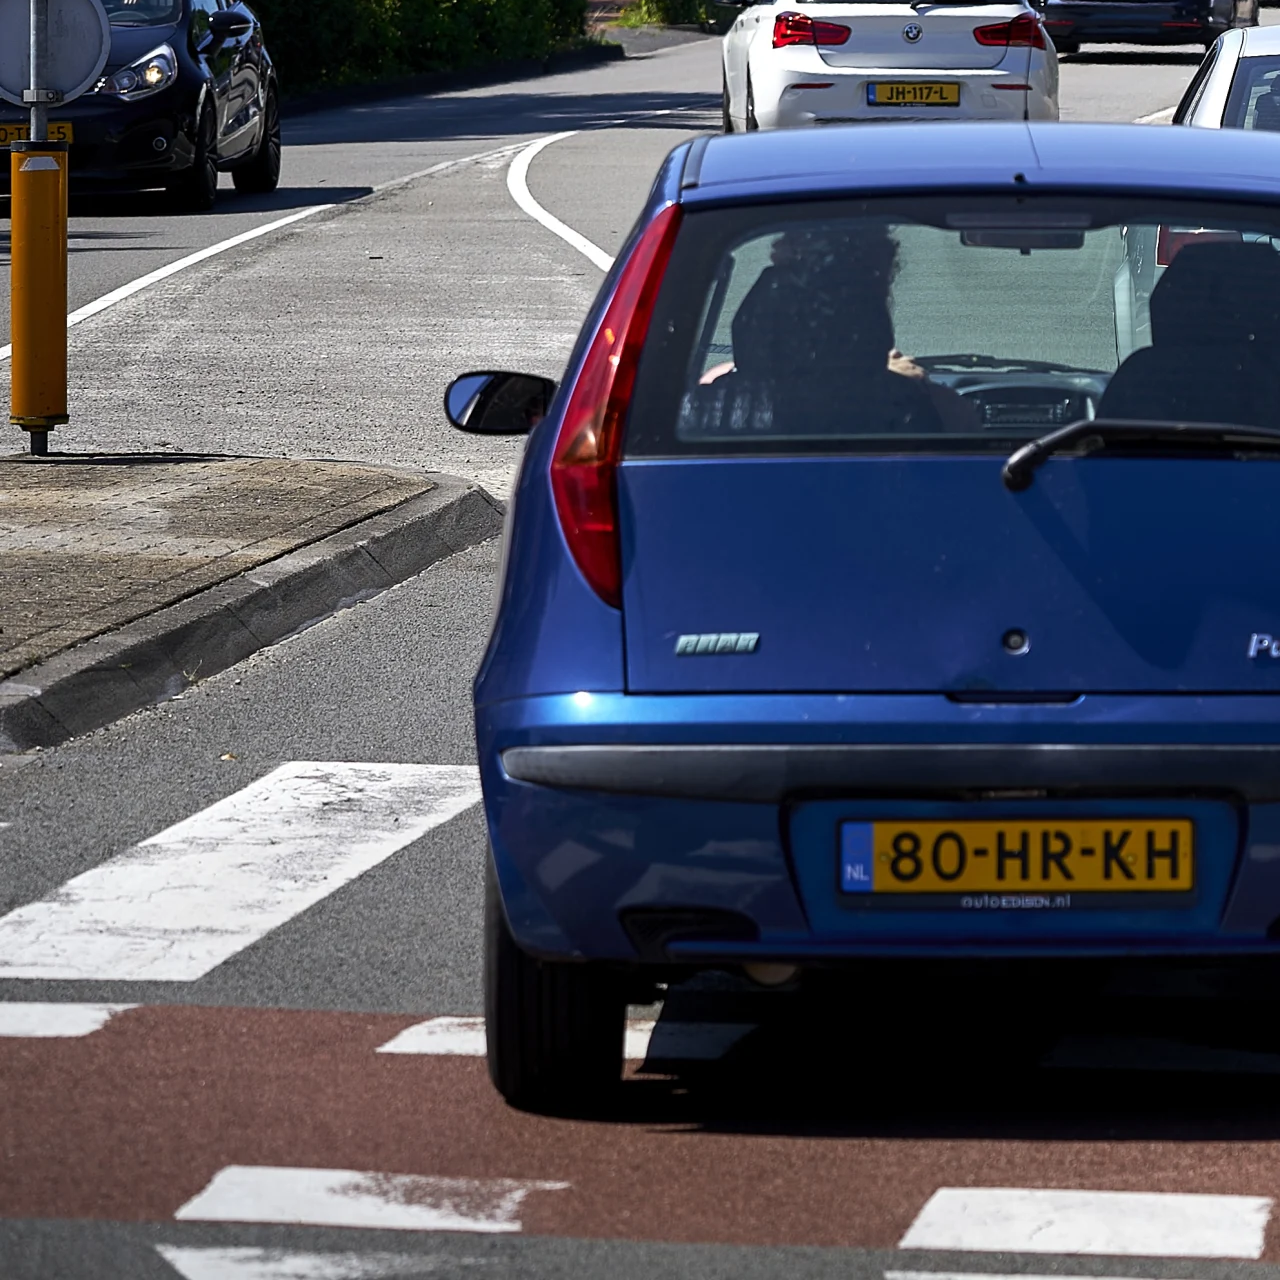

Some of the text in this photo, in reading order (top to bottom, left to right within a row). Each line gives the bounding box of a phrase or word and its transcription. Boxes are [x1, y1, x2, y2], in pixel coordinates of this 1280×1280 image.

[887, 86, 949, 101] JH-117-L
[846, 829, 1181, 883] NL 80-HR-KH
